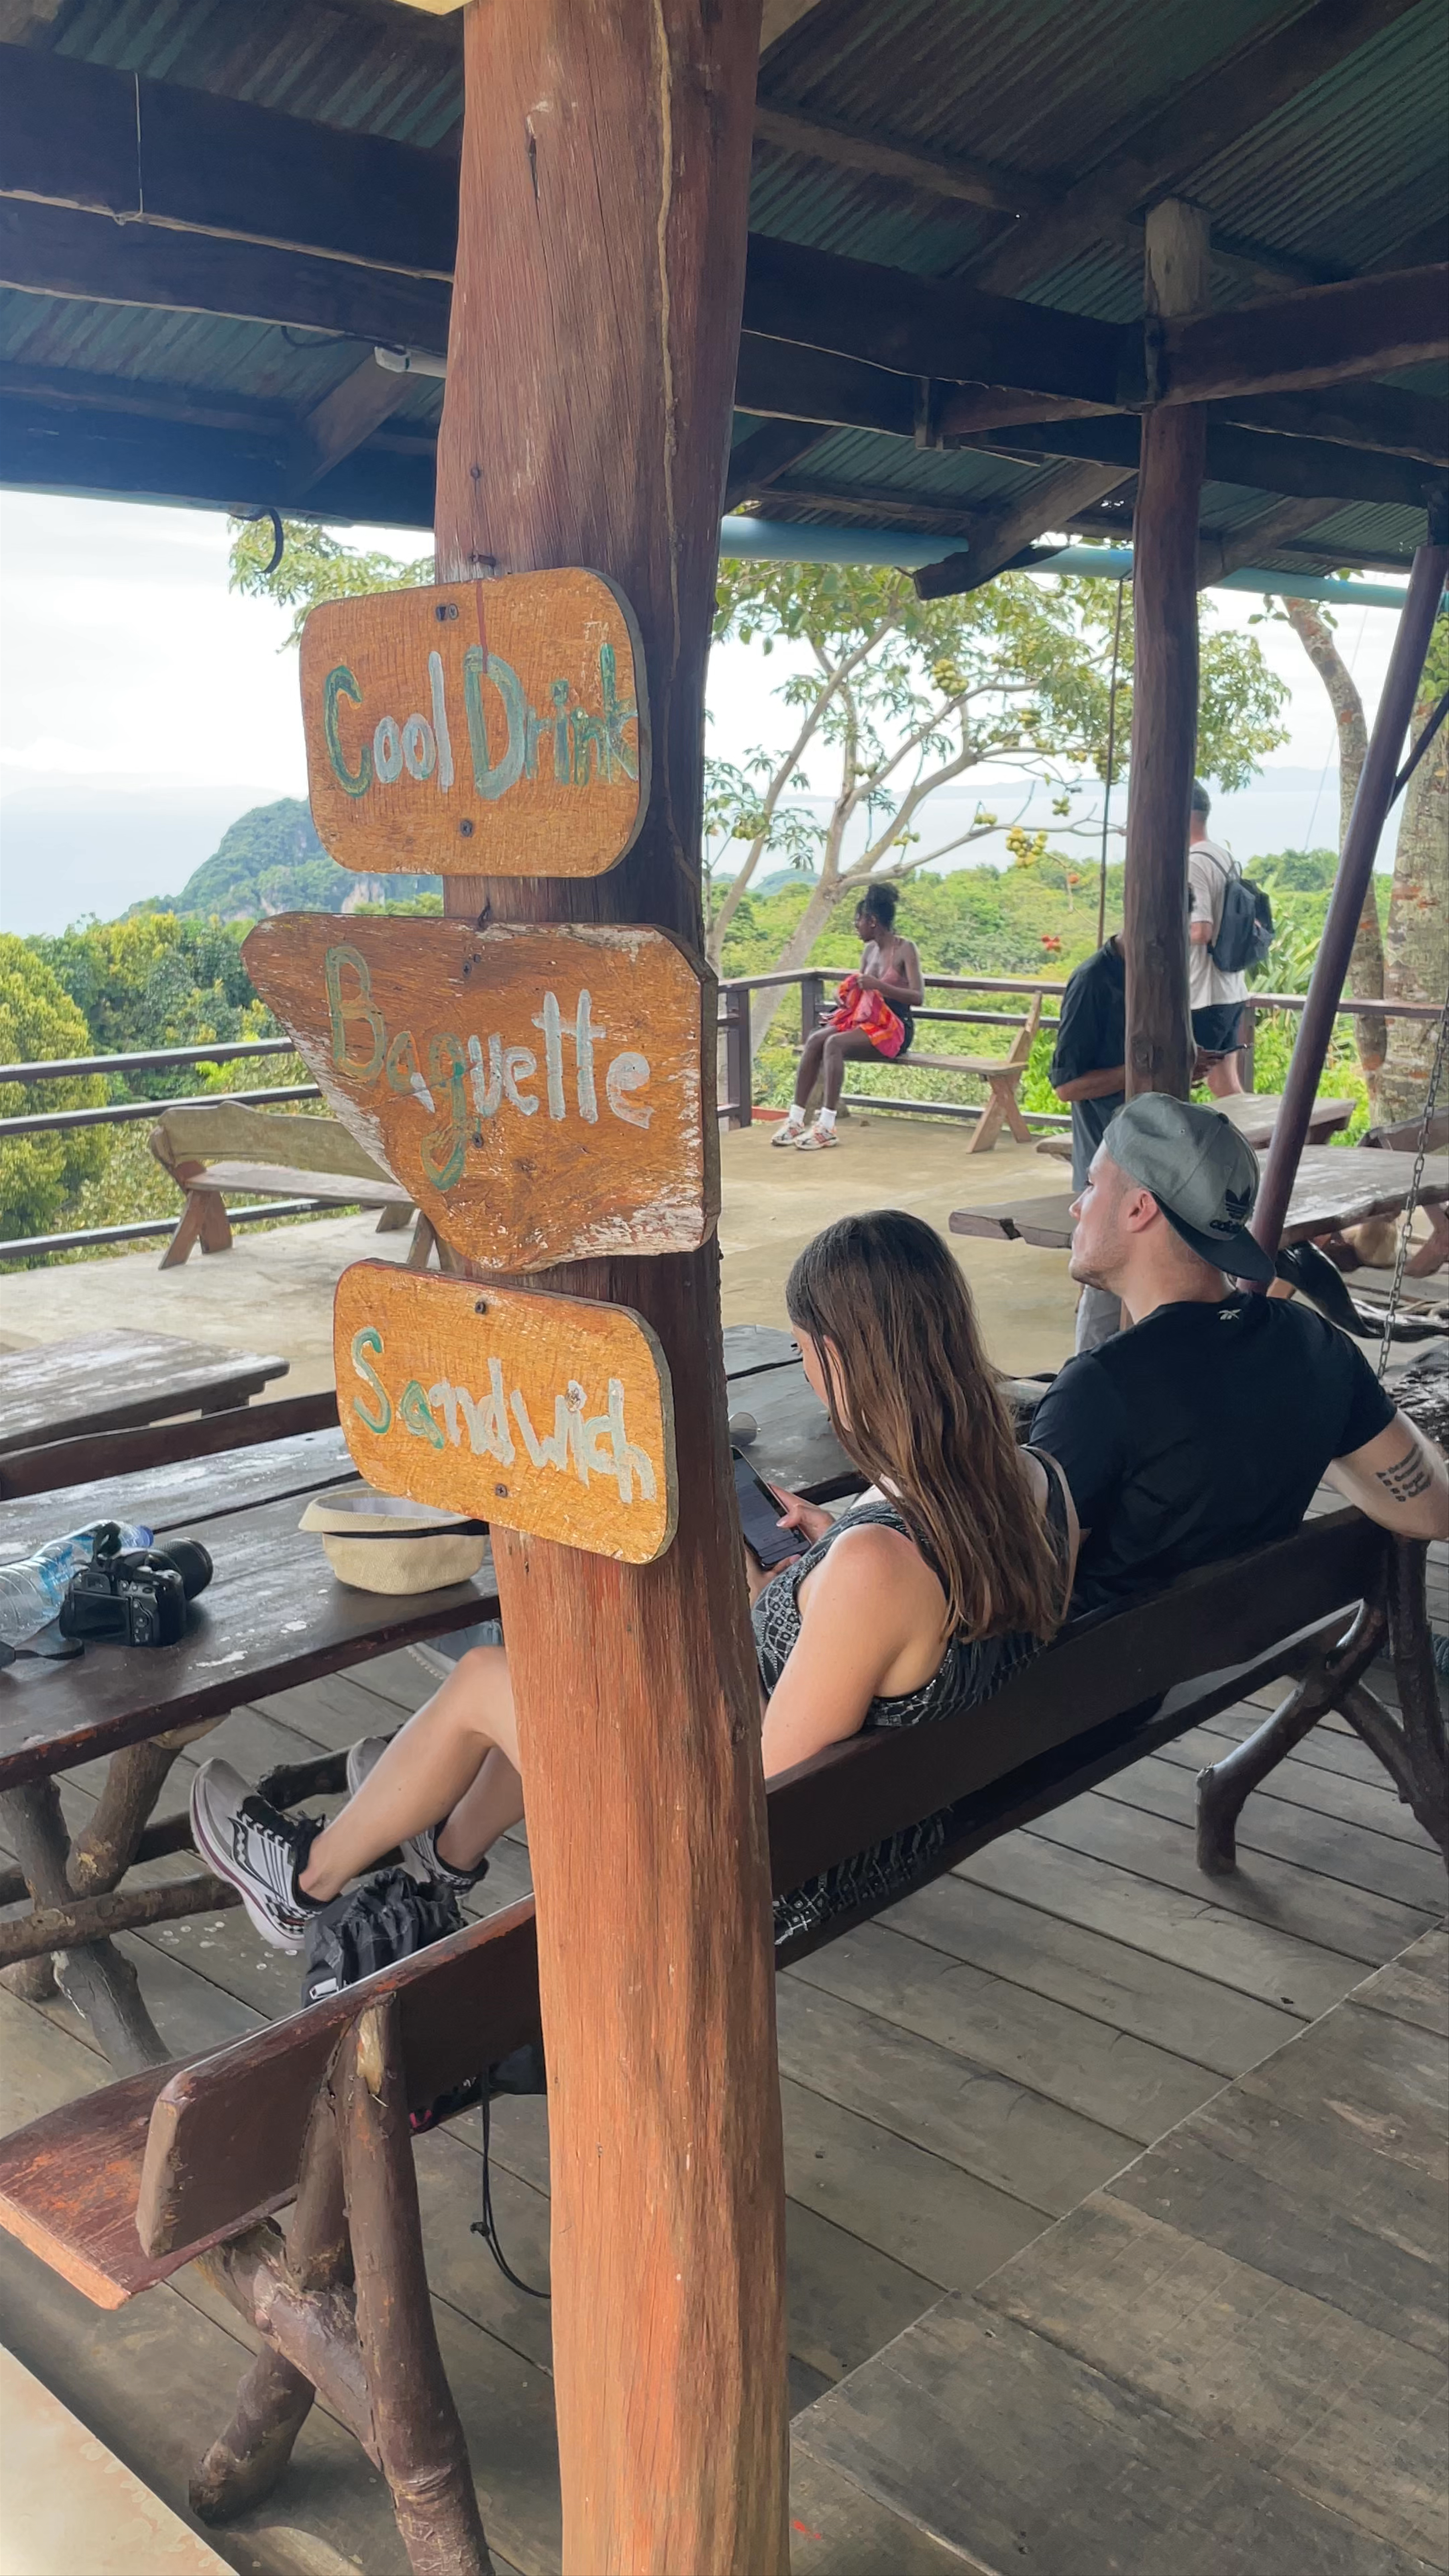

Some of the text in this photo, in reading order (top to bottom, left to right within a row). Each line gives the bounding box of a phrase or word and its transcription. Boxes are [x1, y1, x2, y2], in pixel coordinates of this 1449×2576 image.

[324, 643, 638, 800] Cool Drink
[325, 944, 655, 1190] Baguette
[351, 1326, 657, 1504] Sandwich
